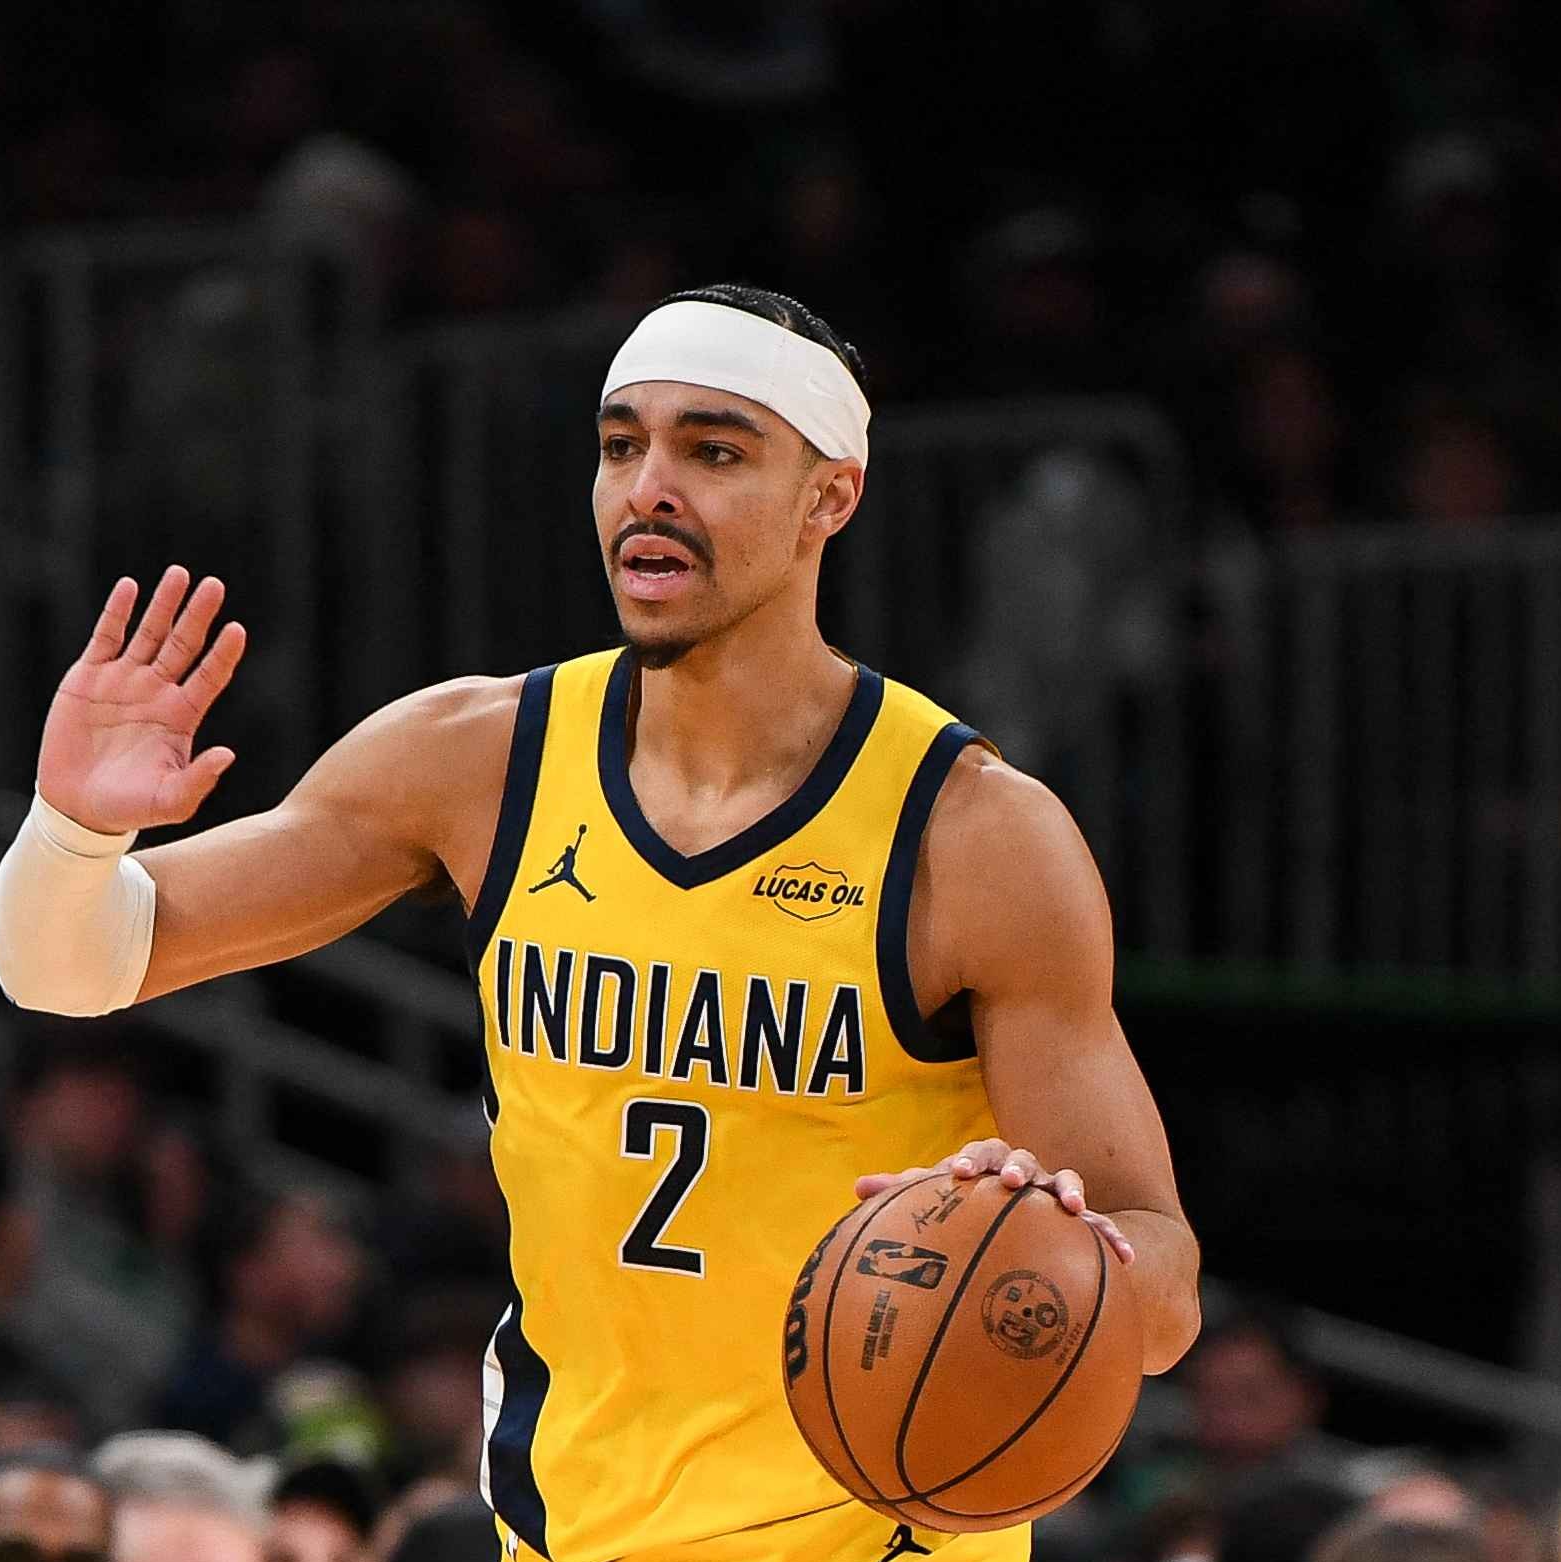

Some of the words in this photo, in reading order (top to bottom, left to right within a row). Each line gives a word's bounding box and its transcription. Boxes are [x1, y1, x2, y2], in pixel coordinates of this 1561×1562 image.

[752, 875, 828, 903] LUCAS
[831, 884, 865, 906] OIL
[495, 936, 866, 1097] INDIANA
[618, 1096, 711, 1279] 2
